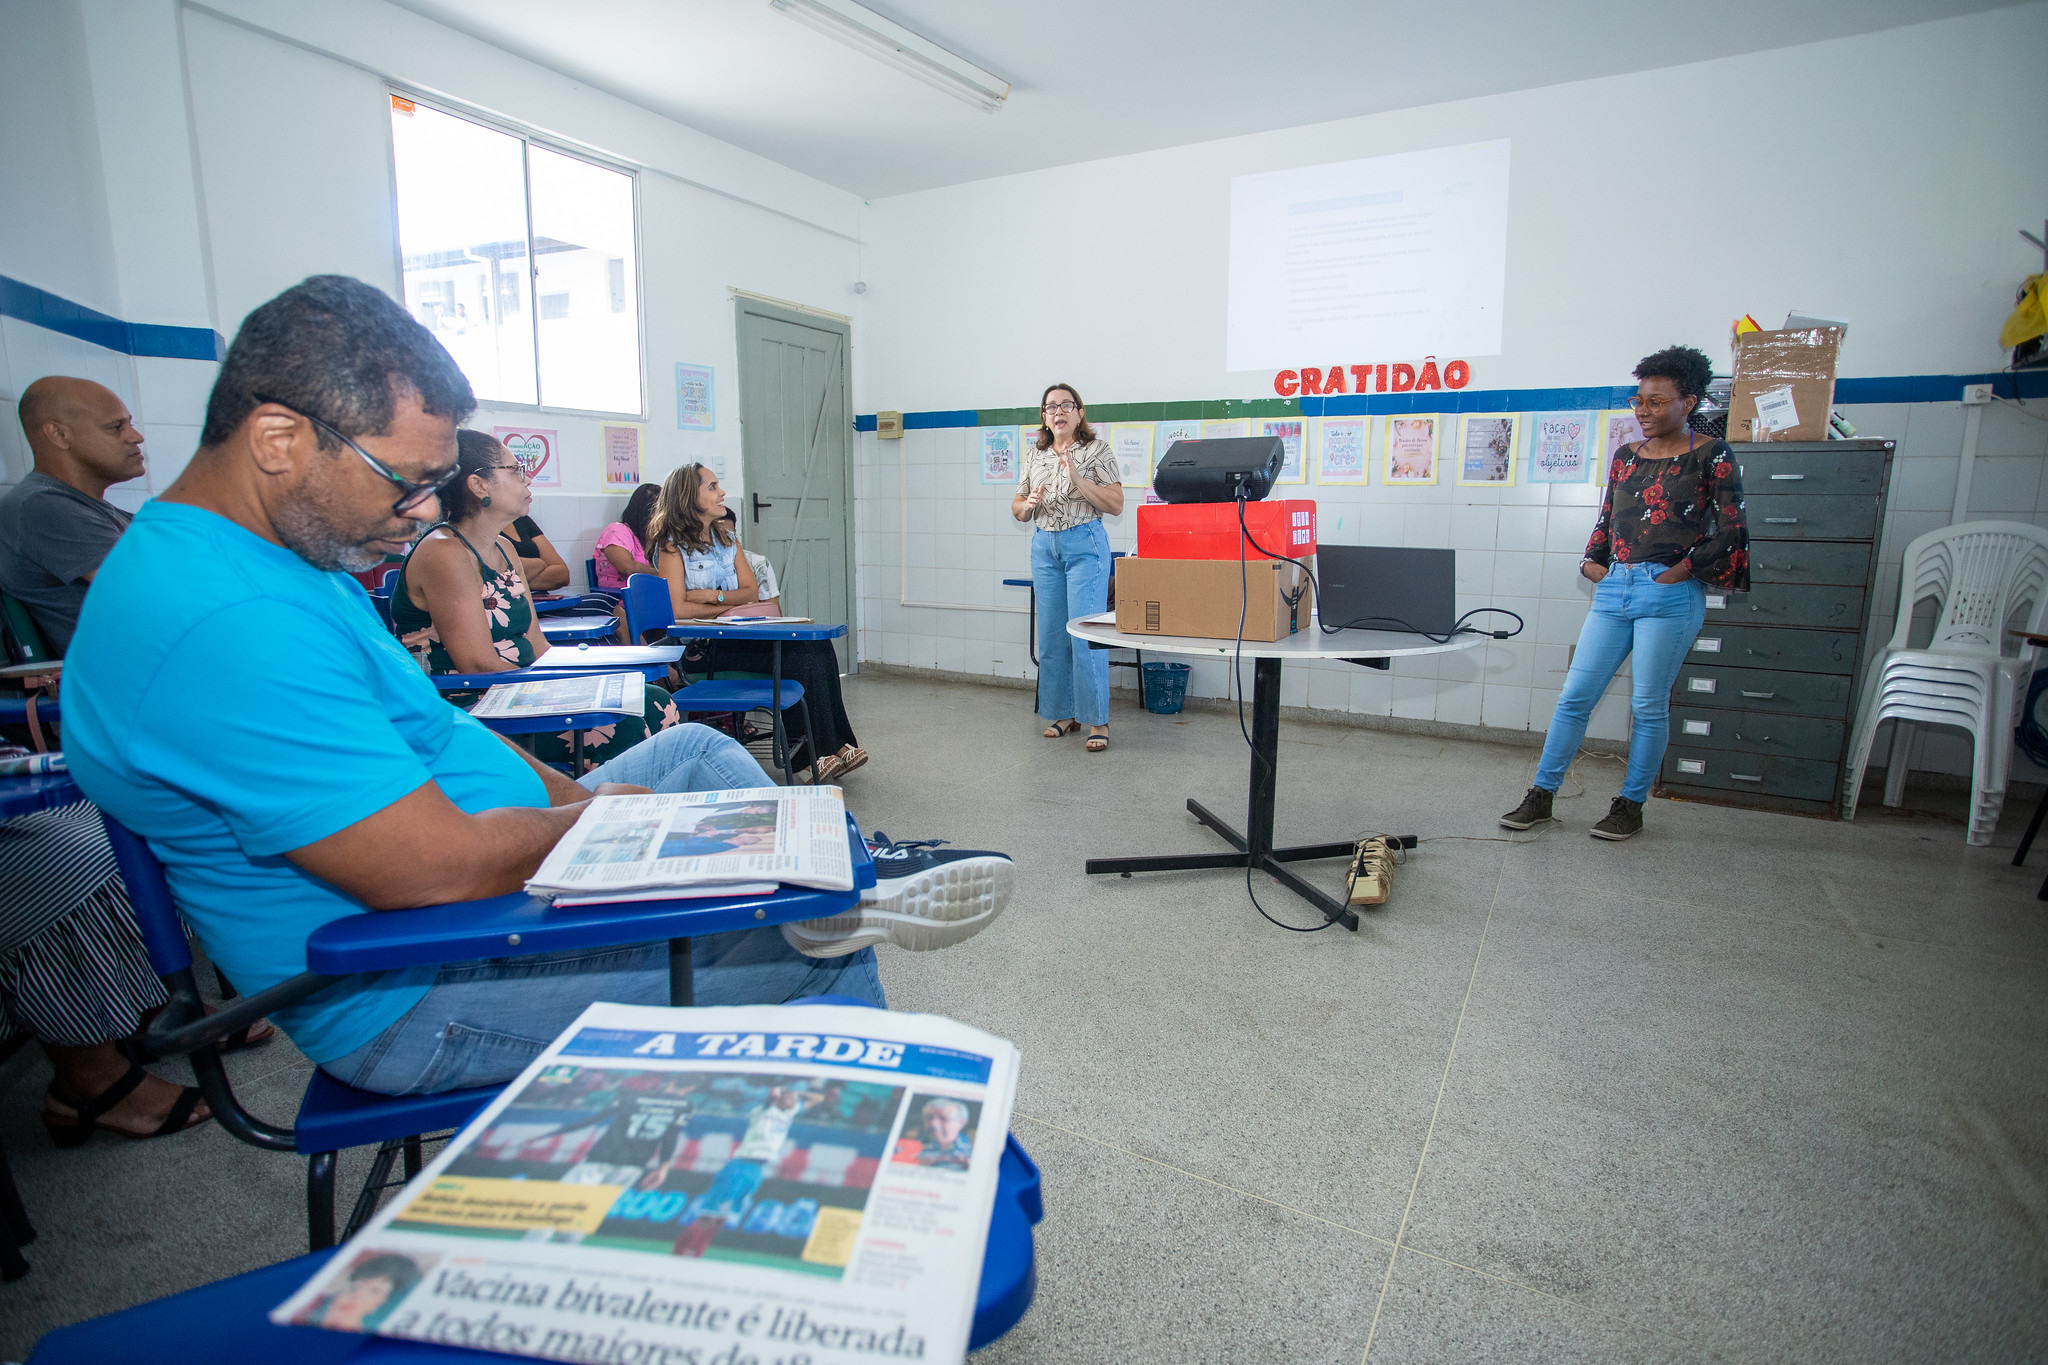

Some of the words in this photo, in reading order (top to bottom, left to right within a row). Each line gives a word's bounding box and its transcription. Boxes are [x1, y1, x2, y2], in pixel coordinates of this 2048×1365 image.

[1274, 355, 1471, 397] GRATIDÃO
[634, 1032, 677, 1056] A
[697, 1032, 907, 1069] TARDE
[424, 1310, 538, 1353] todos
[534, 1324, 706, 1365] maiores
[431, 1266, 549, 1309] Vacina
[553, 1277, 731, 1333] bivalente
[735, 1301, 763, 1338] é
[766, 1305, 927, 1361] liberada
